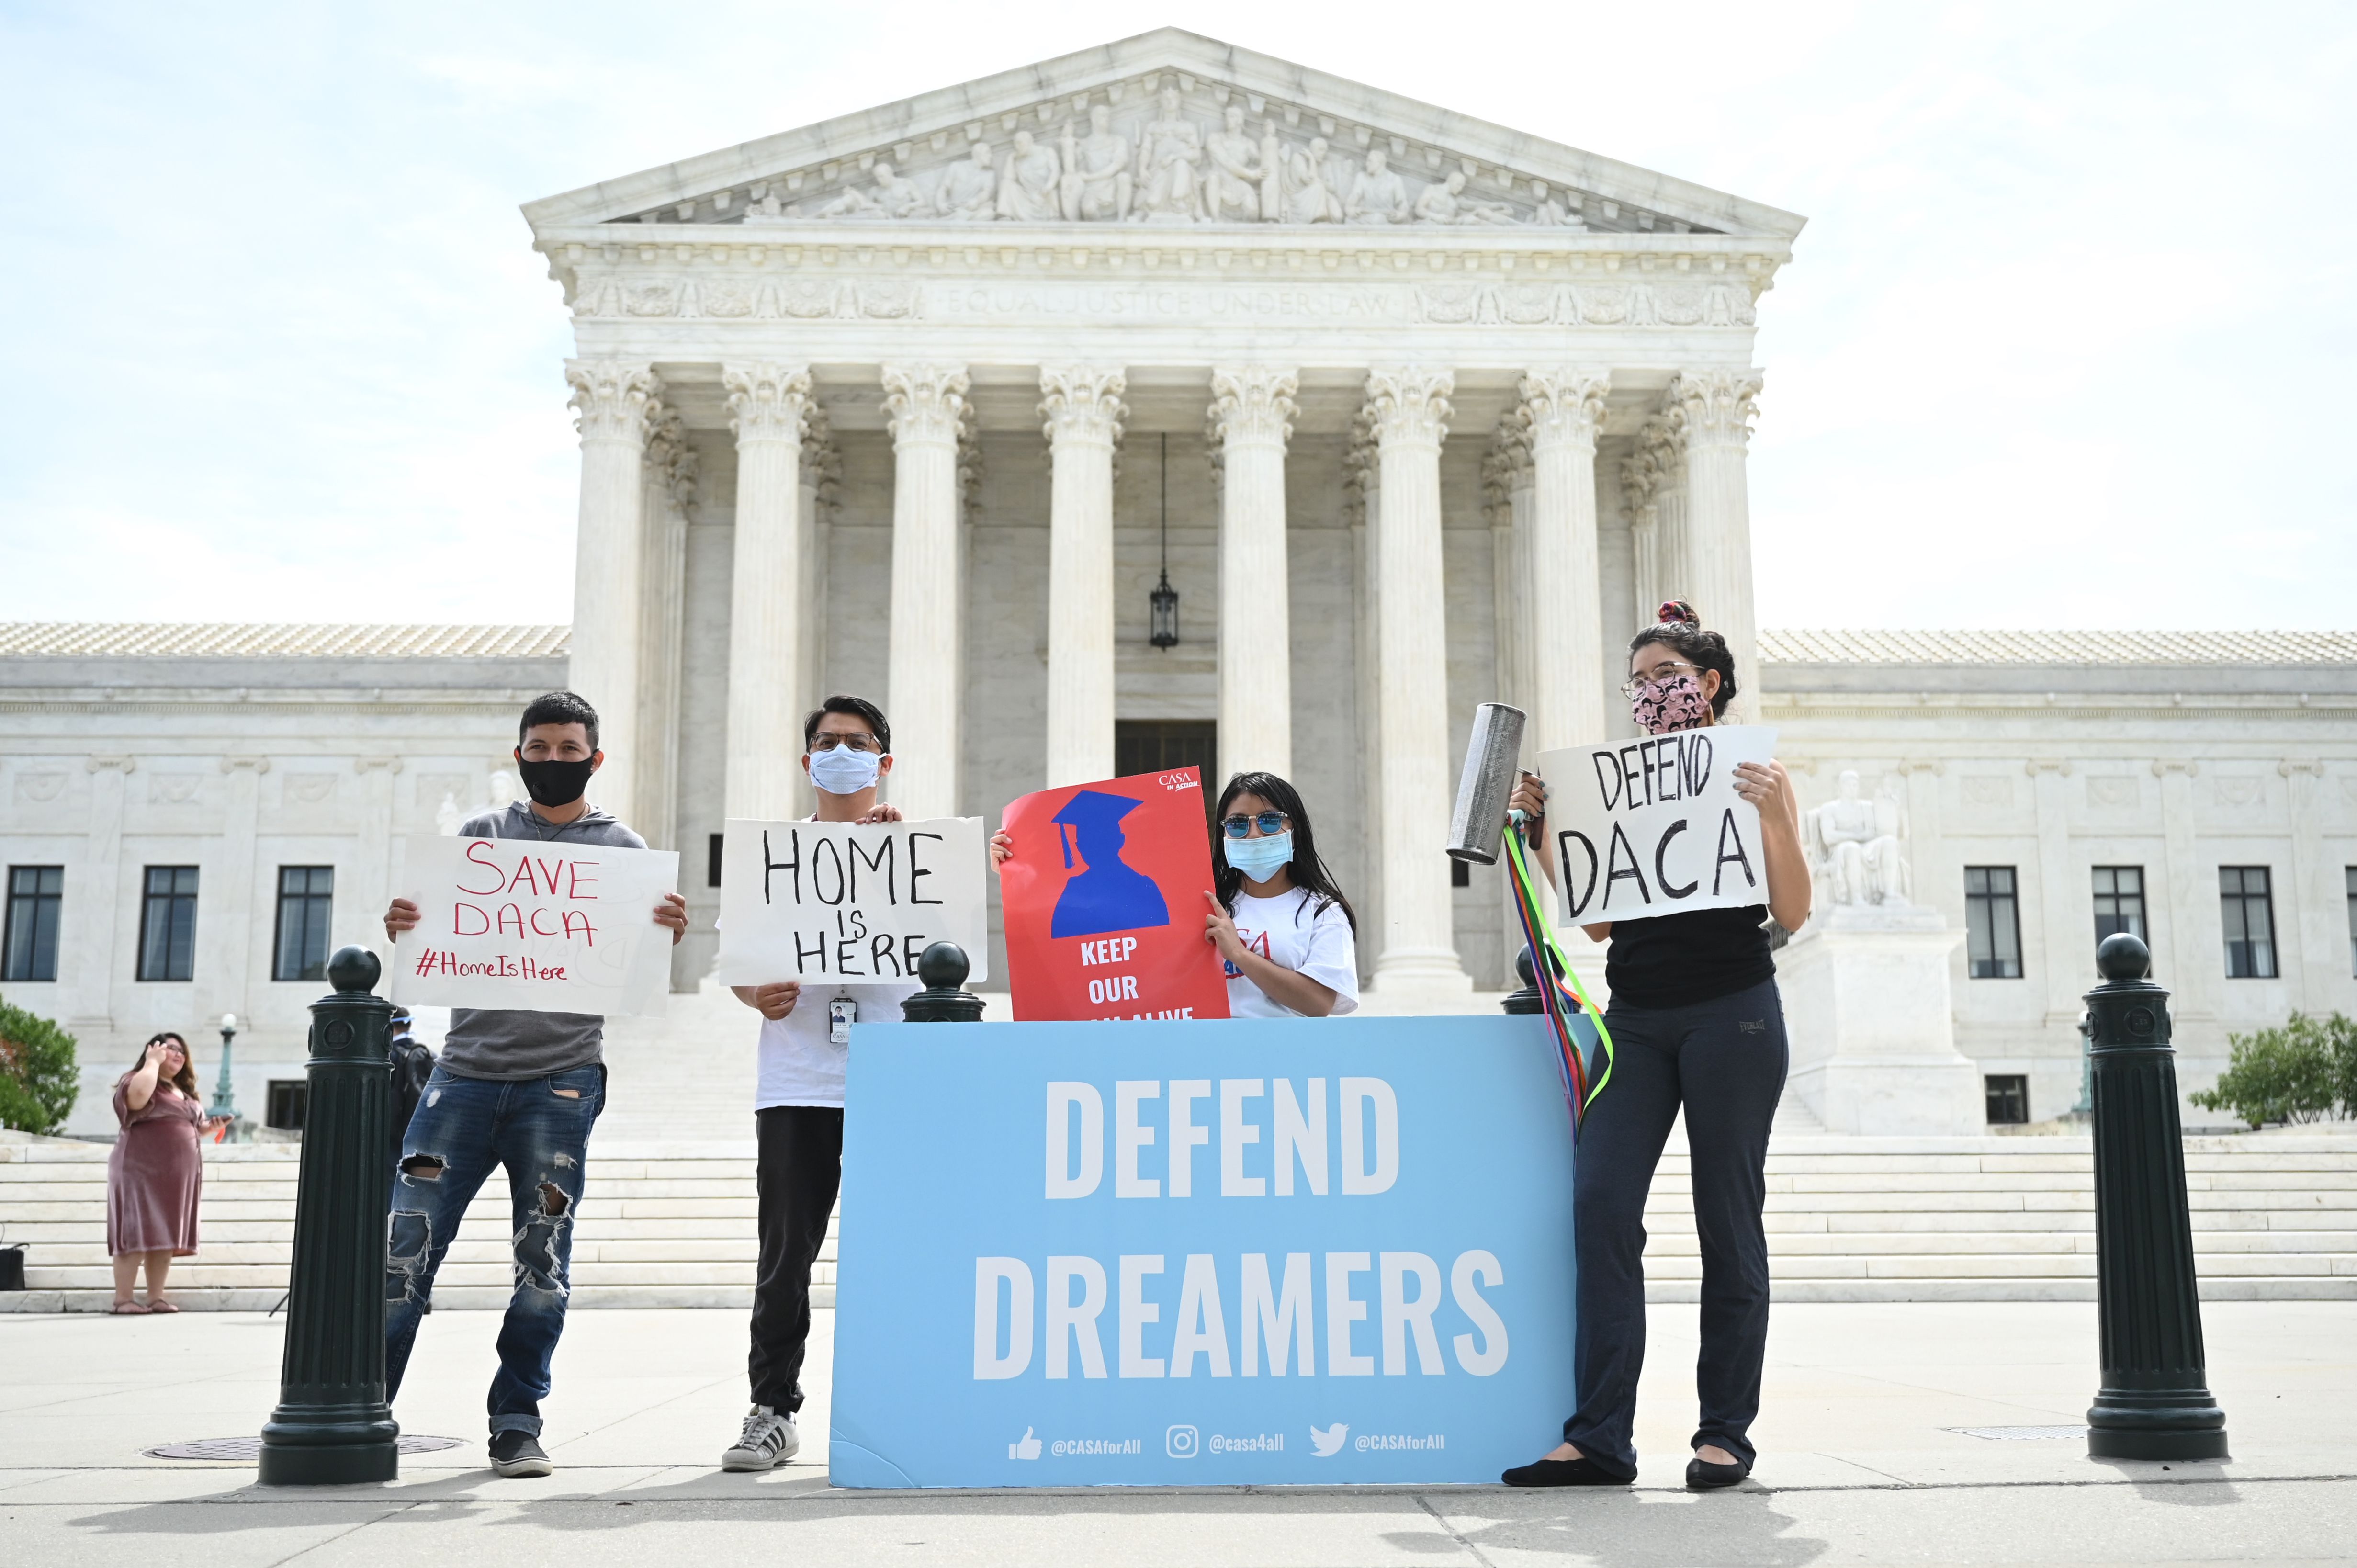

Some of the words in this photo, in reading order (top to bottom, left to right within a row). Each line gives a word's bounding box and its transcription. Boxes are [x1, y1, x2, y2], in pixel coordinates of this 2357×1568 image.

[948, 290, 1054, 315] EQUAL
[1064, 291, 1191, 315] JUSTICE
[1208, 292, 1314, 315] UNDER
[1328, 293, 1389, 316] LAW
[1158, 772, 1192, 785] CASA
[1175, 781, 1198, 789] ACTION
[1592, 734, 1713, 812] DEFEND
[456, 841, 600, 899] SAVE
[763, 829, 943, 905] HOME
[1559, 808, 1756, 918] DACA
[453, 903, 598, 947] DACA
[837, 910, 867, 939] IS
[416, 948, 568, 981] #HomeIsHere
[794, 931, 925, 977] HERE
[1081, 936, 1137, 966] KEEP
[1088, 975, 1139, 1004] OUR
[1045, 1077, 1399, 1199] DEFEND
[973, 1249, 1509, 1380] DREAMERS
[1051, 1439, 1141, 1456] @CASAforAll
[1209, 1433, 1284, 1455] @casa4all
[1355, 1434, 1444, 1452] @CASAforAll
